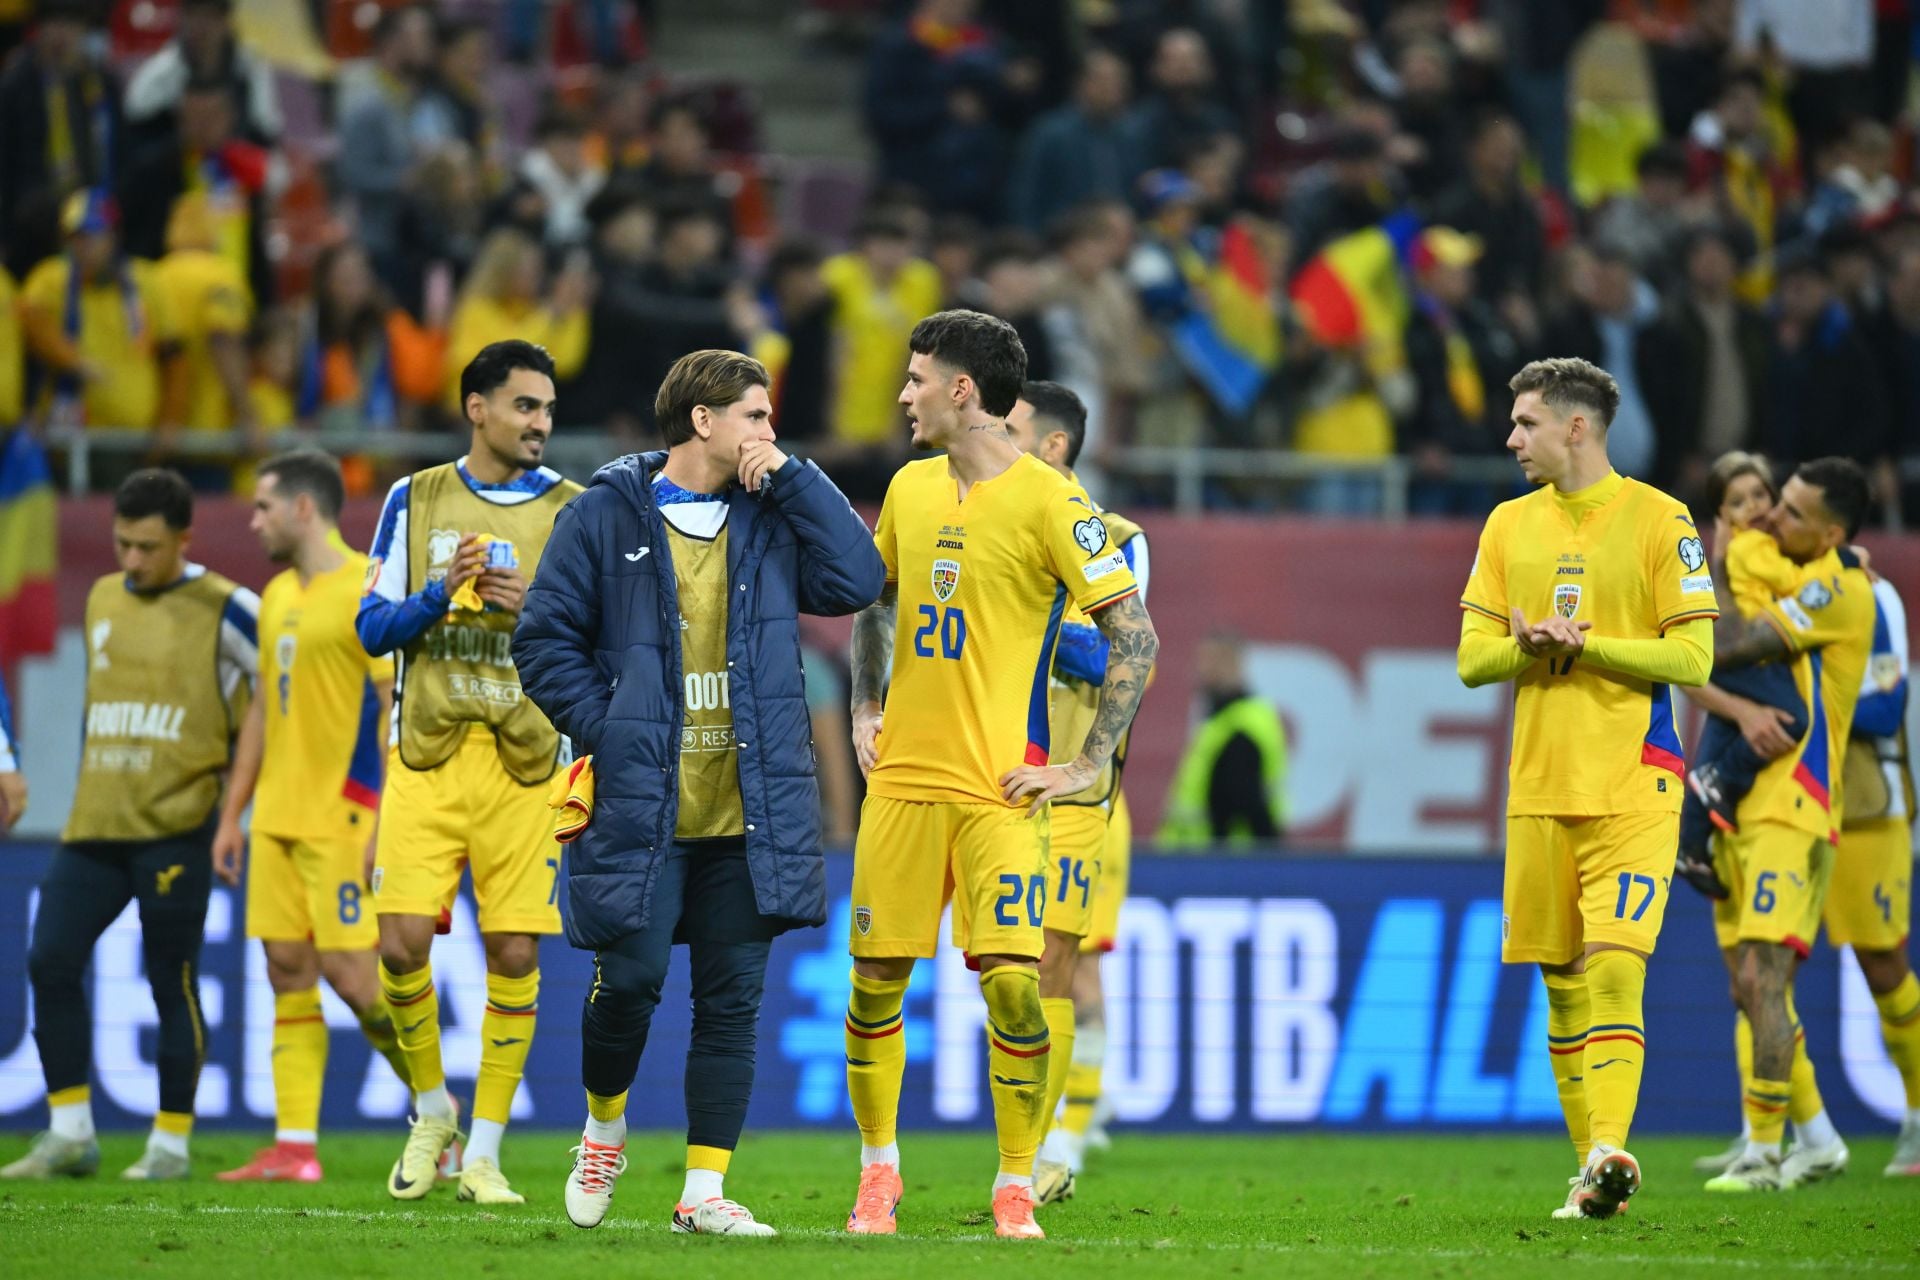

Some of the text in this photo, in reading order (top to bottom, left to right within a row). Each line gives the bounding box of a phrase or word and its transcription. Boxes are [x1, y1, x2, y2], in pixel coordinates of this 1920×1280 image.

[914, 604, 967, 661] 20
[337, 881, 362, 925] 8
[993, 874, 1046, 927] 20
[1056, 856, 1090, 908] 14
[1615, 872, 1655, 921] 17
[1753, 870, 1777, 914] 6
[1873, 882, 1891, 923] 4
